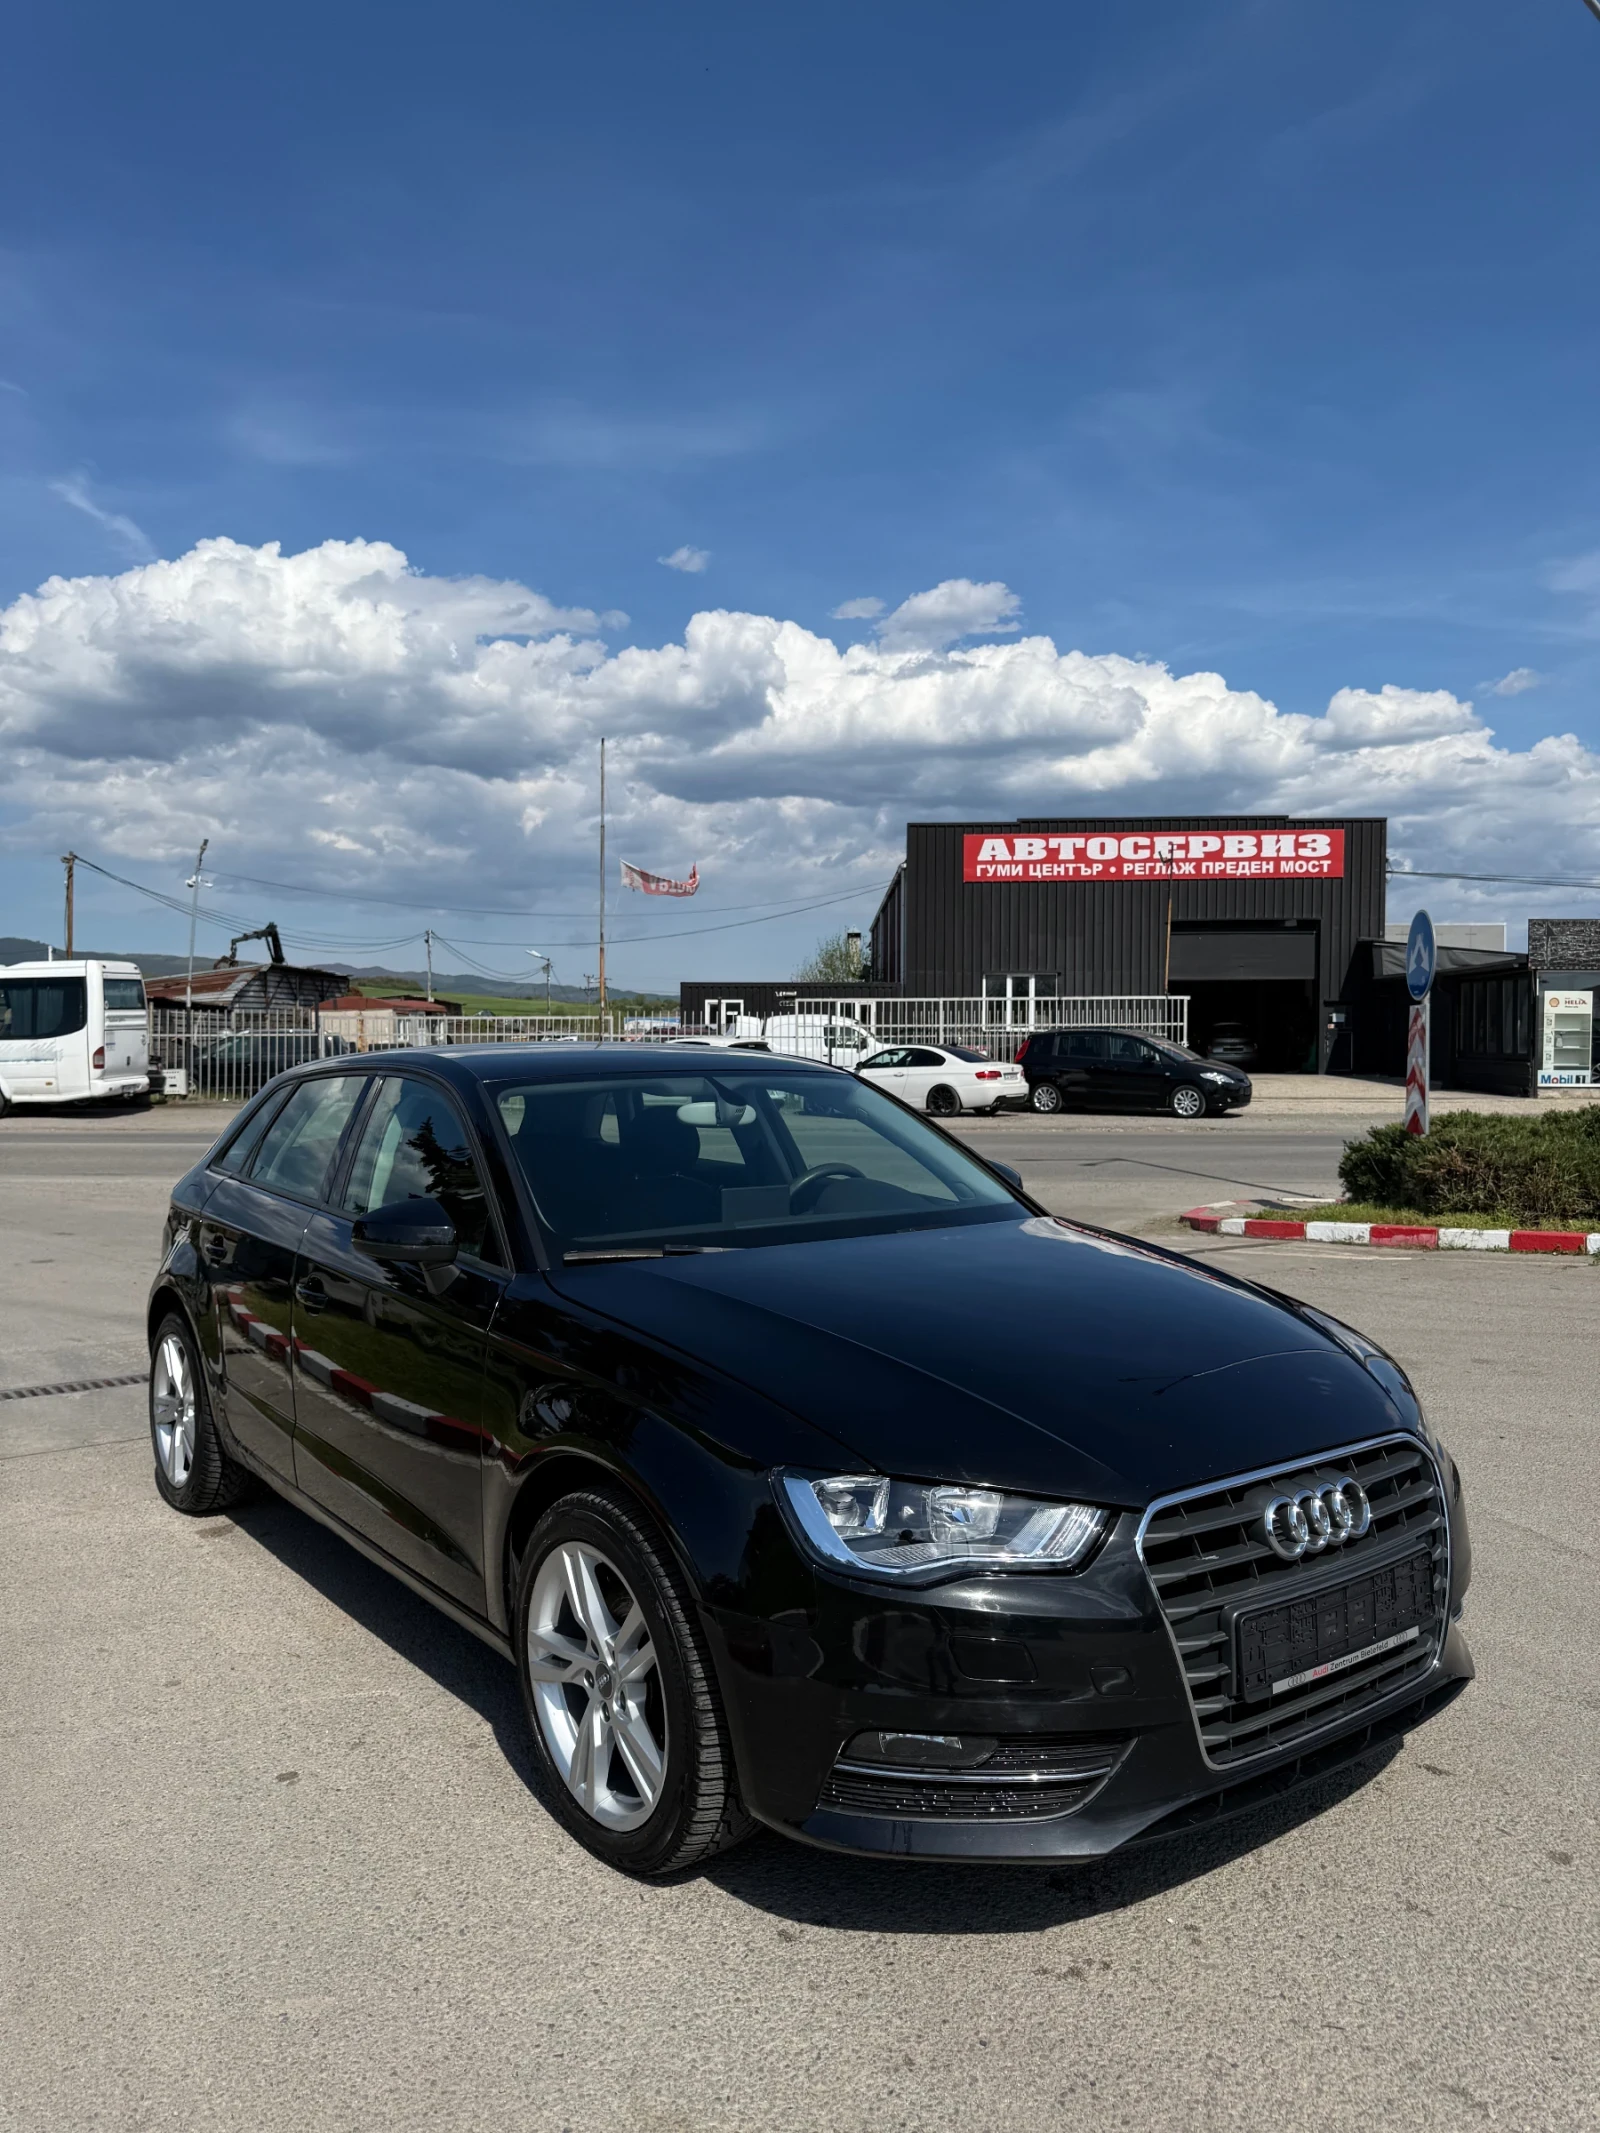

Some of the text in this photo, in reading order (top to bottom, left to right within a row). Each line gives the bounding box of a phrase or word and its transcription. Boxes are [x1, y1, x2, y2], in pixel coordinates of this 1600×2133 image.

[977, 834, 1331, 862] АВТОСЕРВИЗ
[976, 860, 1332, 878] ГУМИ ЦЕНТЪР РЕГЛАЖ ПРЕДЕН МОСТ
[1541, 1074, 1573, 1084] Mobil
[1312, 1641, 1389, 1678] Audi Zentrum Bielefeld
